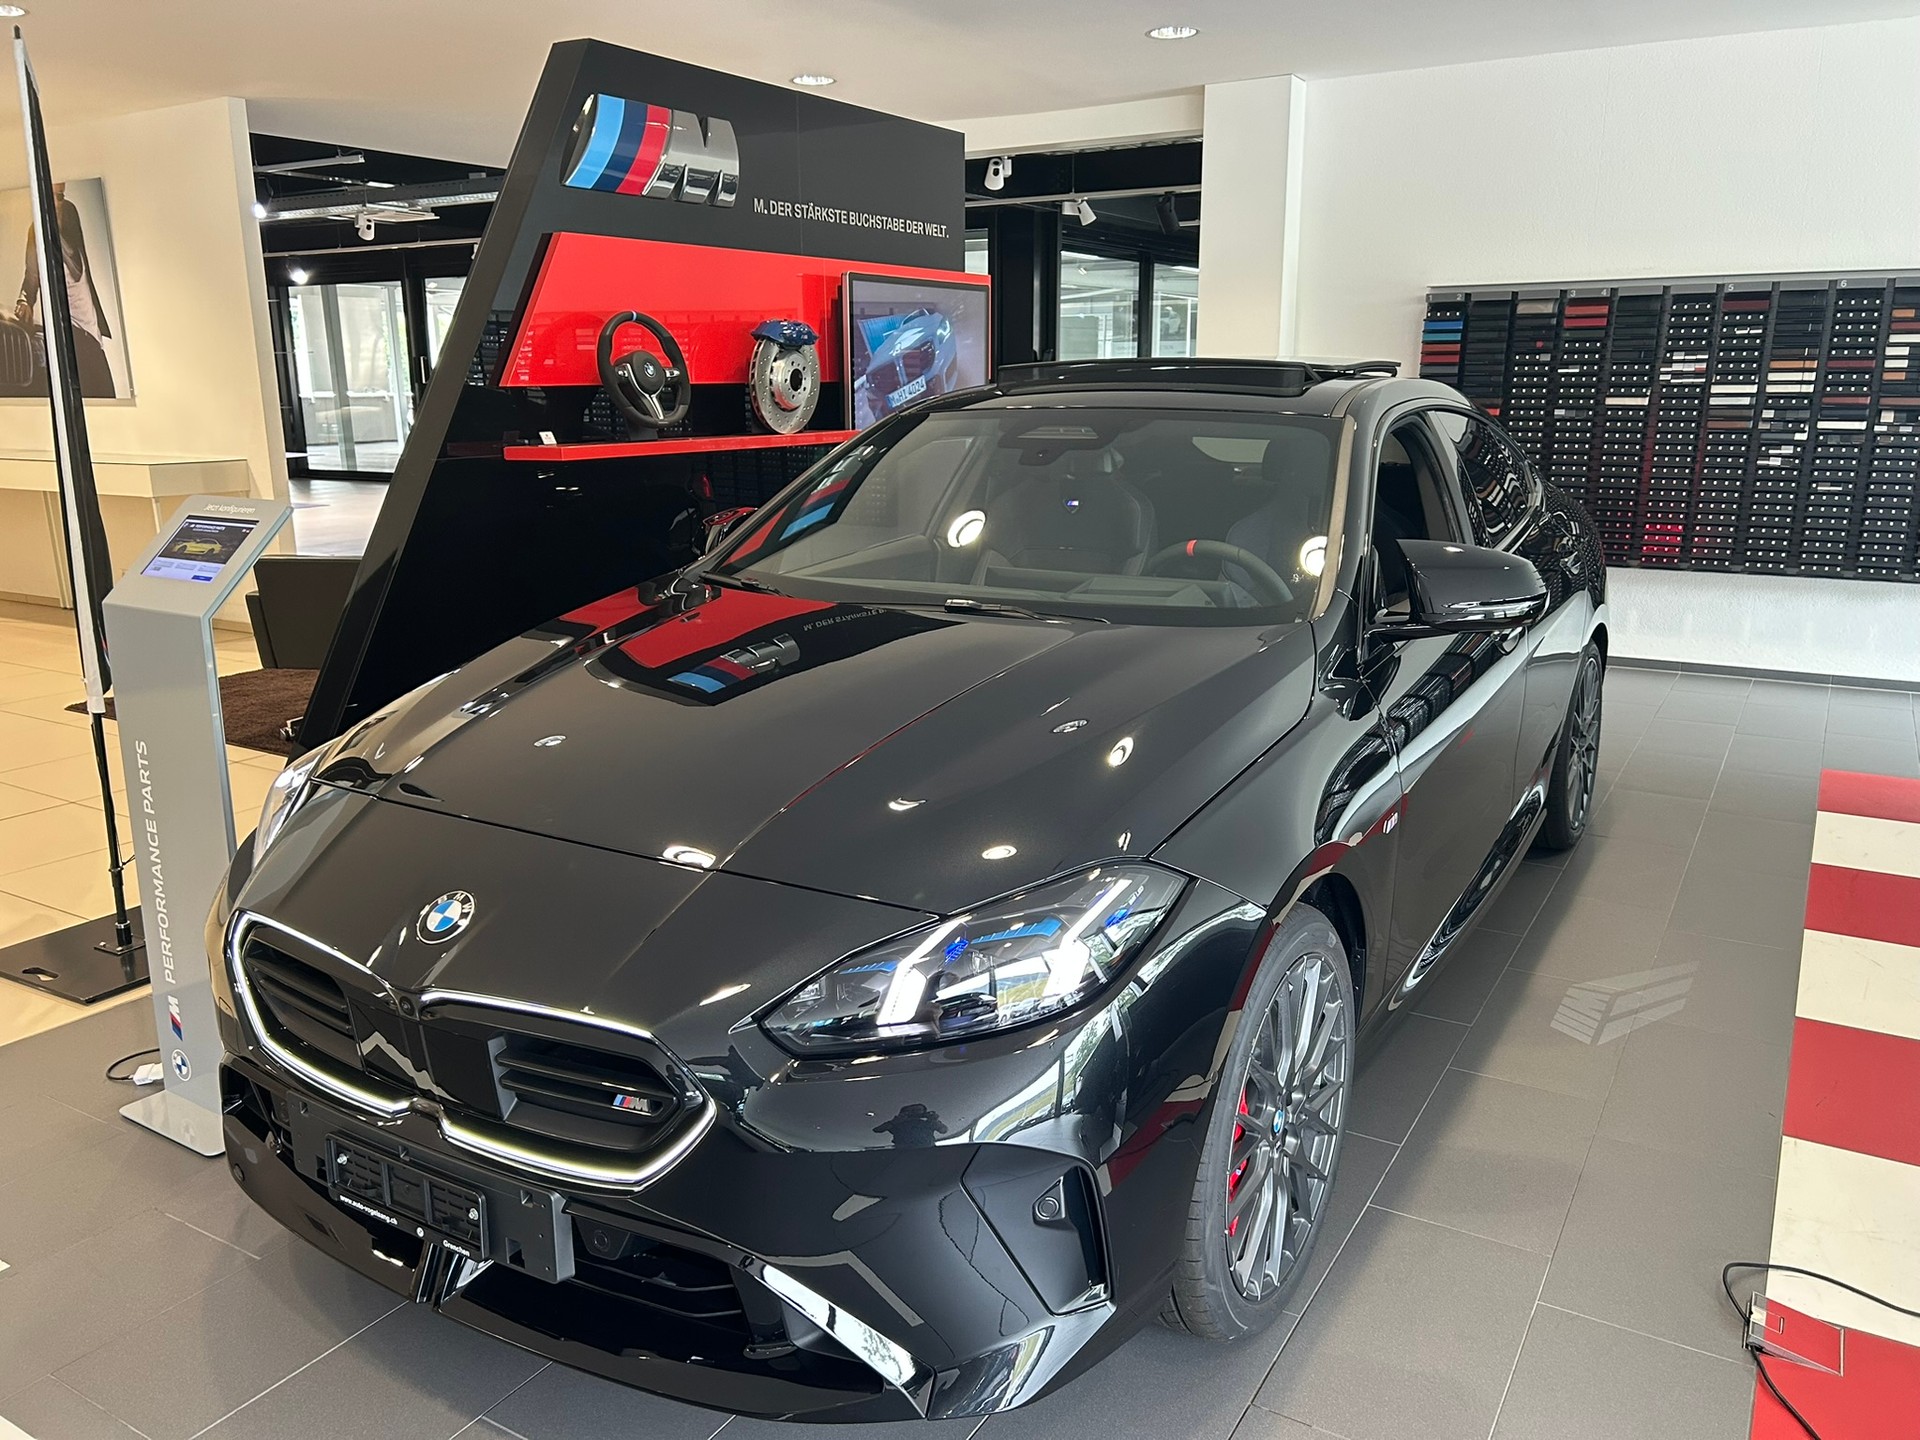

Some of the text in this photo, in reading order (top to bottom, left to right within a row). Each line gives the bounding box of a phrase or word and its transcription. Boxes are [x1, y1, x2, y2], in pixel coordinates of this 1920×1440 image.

[753, 198, 950, 238] M. DER STÄRKSTE BUCHSTABE DER WELT.
[1728, 284, 1735, 292] 5
[1840, 280, 1847, 288] 6
[1570, 288, 1607, 297] 3 4
[219, 504, 256, 514] konfigurieren
[136, 740, 155, 815] PARTS
[145, 818, 177, 984] PERFORMANCE
